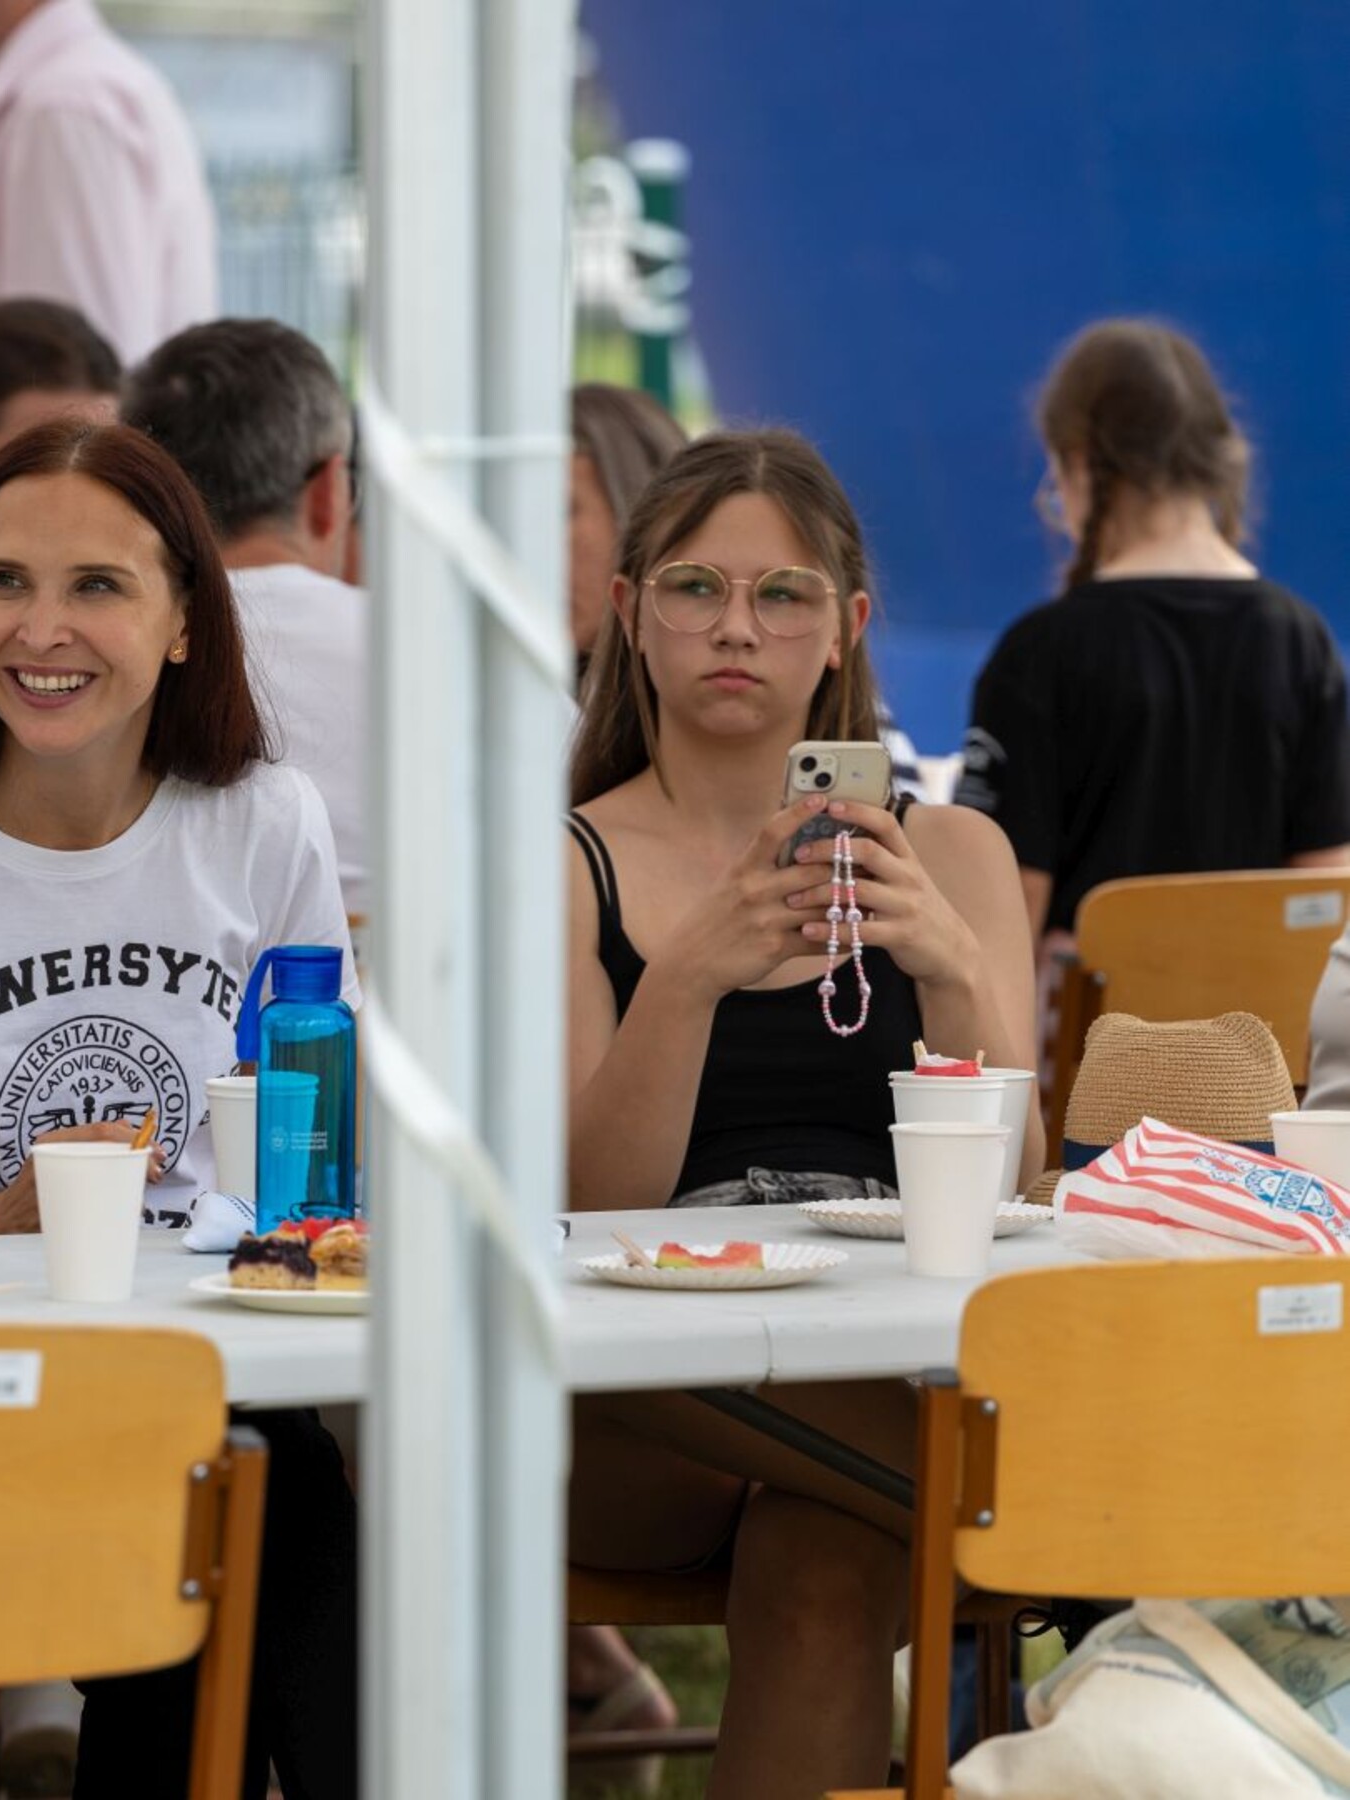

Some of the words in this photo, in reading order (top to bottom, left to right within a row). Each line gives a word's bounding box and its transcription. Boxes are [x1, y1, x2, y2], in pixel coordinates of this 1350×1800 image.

[0, 1022, 134, 1131] UNIVERSITATIS
[139, 1044, 185, 1168] OECONO
[36, 1054, 146, 1102] CATOVICIENSIS
[70, 1075, 114, 1098] 1937
